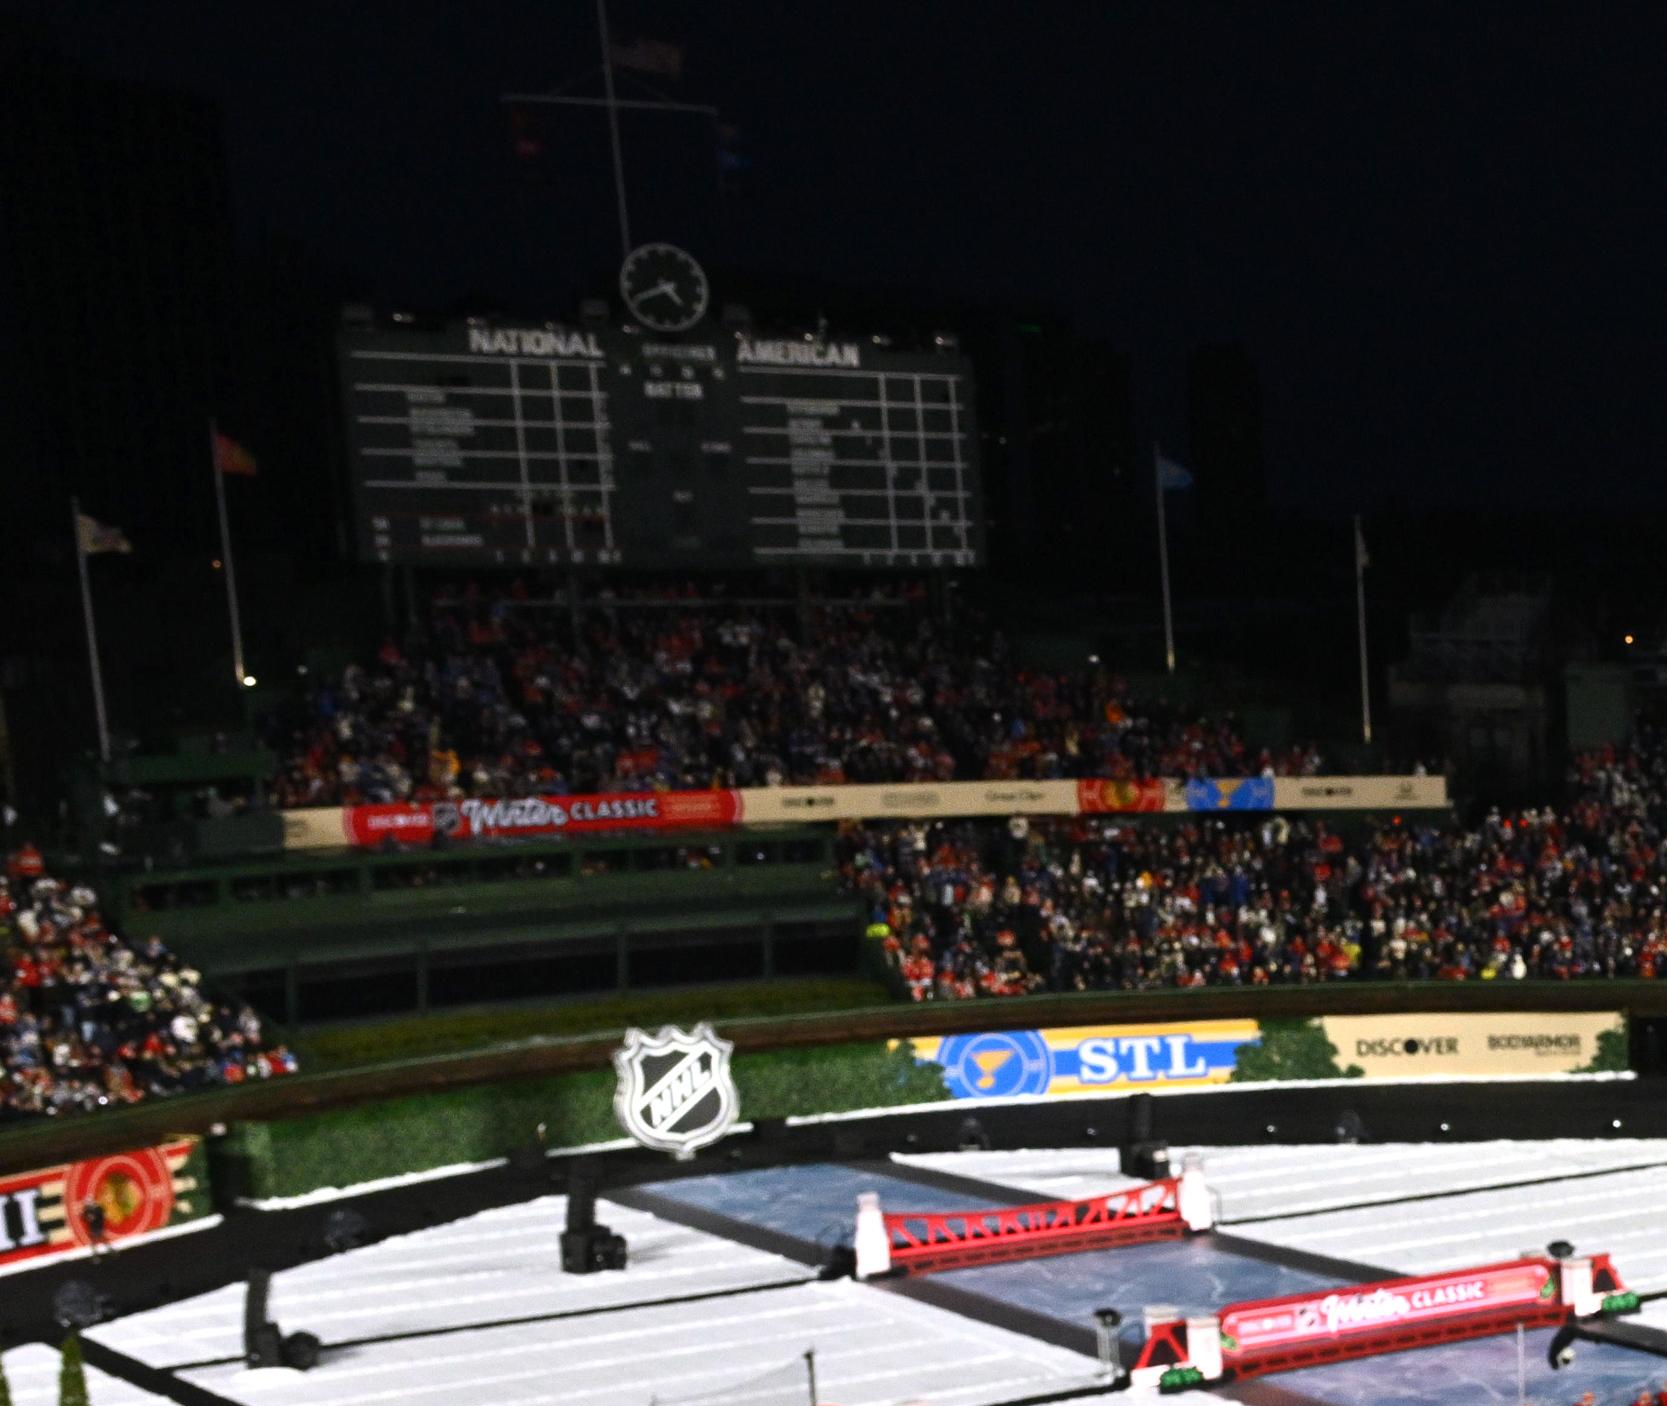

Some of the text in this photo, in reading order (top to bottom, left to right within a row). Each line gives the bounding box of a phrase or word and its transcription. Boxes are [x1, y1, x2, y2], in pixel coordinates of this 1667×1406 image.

[469, 327, 604, 357] NATIONAL
[737, 338, 861, 368] AMERICAN
[461, 797, 569, 834] Winter
[570, 799, 659, 821] CLASSIC
[1079, 1035, 1206, 1083] STL
[1356, 1036, 1460, 1058] DISCOVER
[646, 1055, 715, 1130] NHL
[1411, 1280, 1485, 1308] CLASSIC
